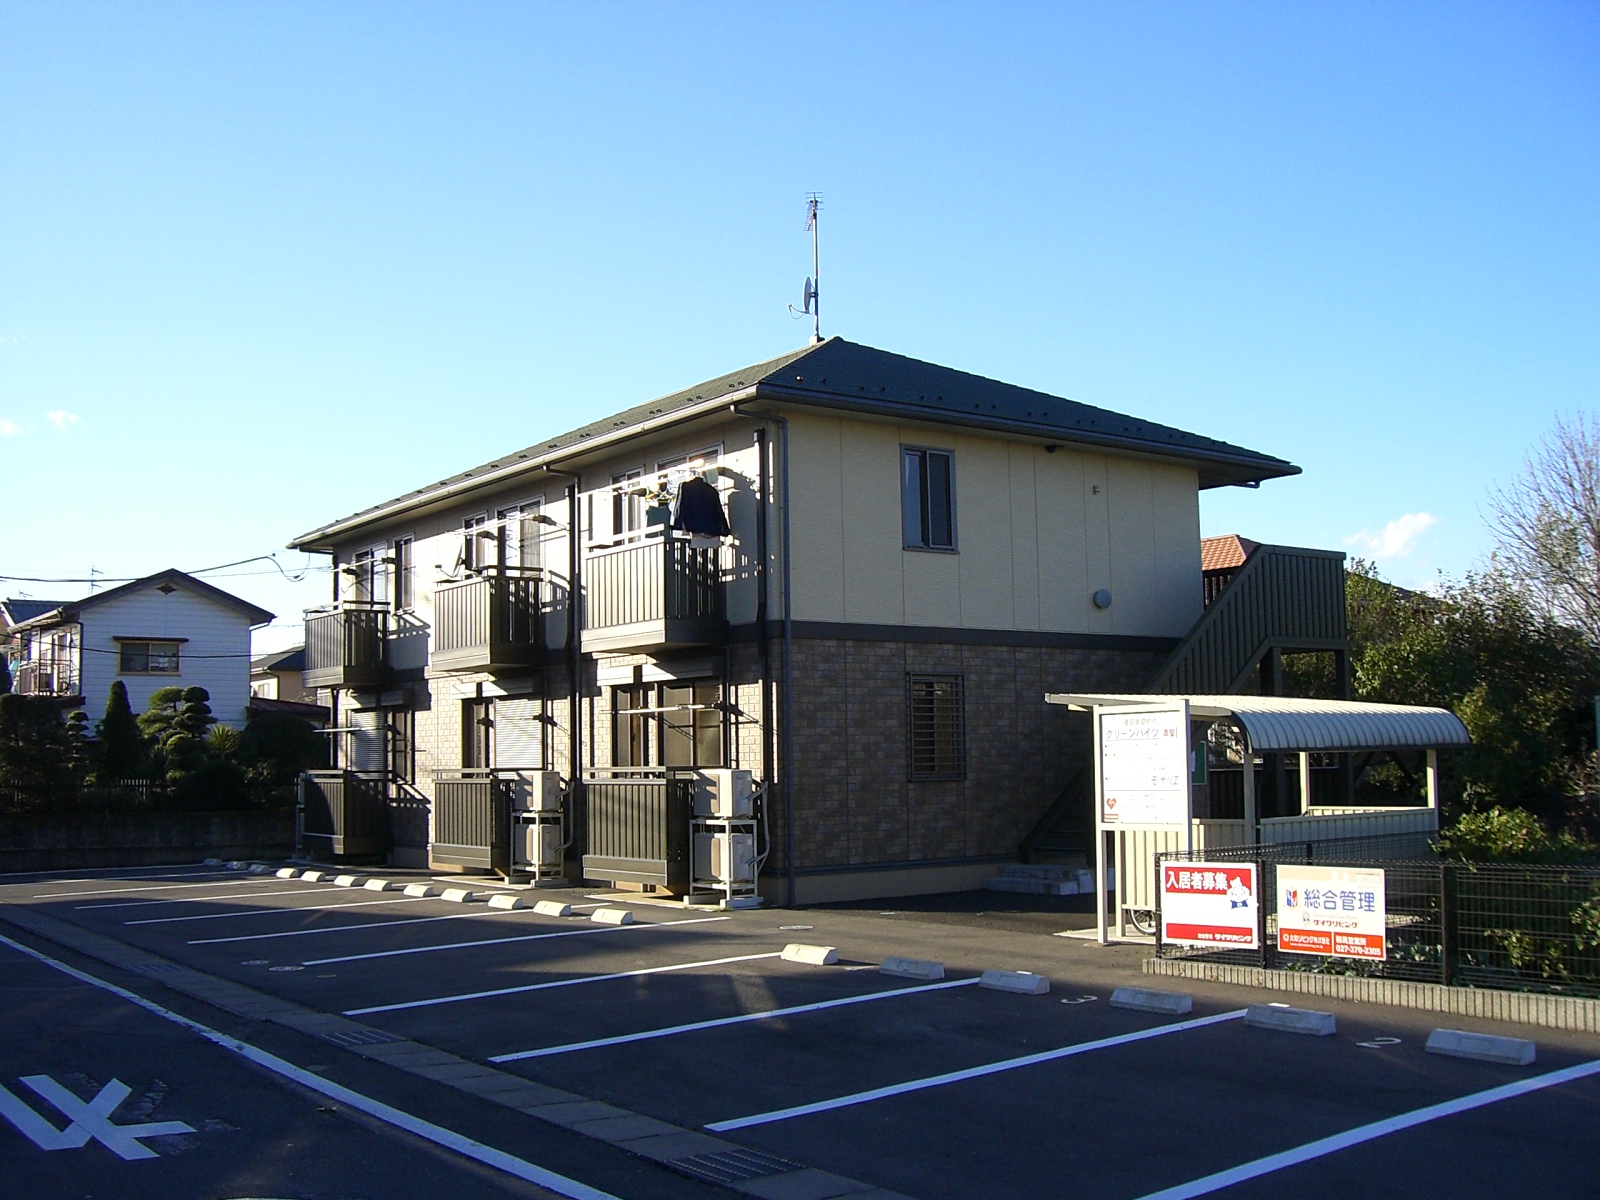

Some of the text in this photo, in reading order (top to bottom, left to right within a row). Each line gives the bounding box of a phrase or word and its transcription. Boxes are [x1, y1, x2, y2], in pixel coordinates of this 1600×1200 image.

[1166, 870, 1228, 891] 入居者募集
[1304, 888, 1376, 912] 総合管理
[1313, 919, 1358, 929] ダイワリビング
[1335, 944, 1381, 956] 027-370-2305
[1356, 1037, 1402, 1049] 2
